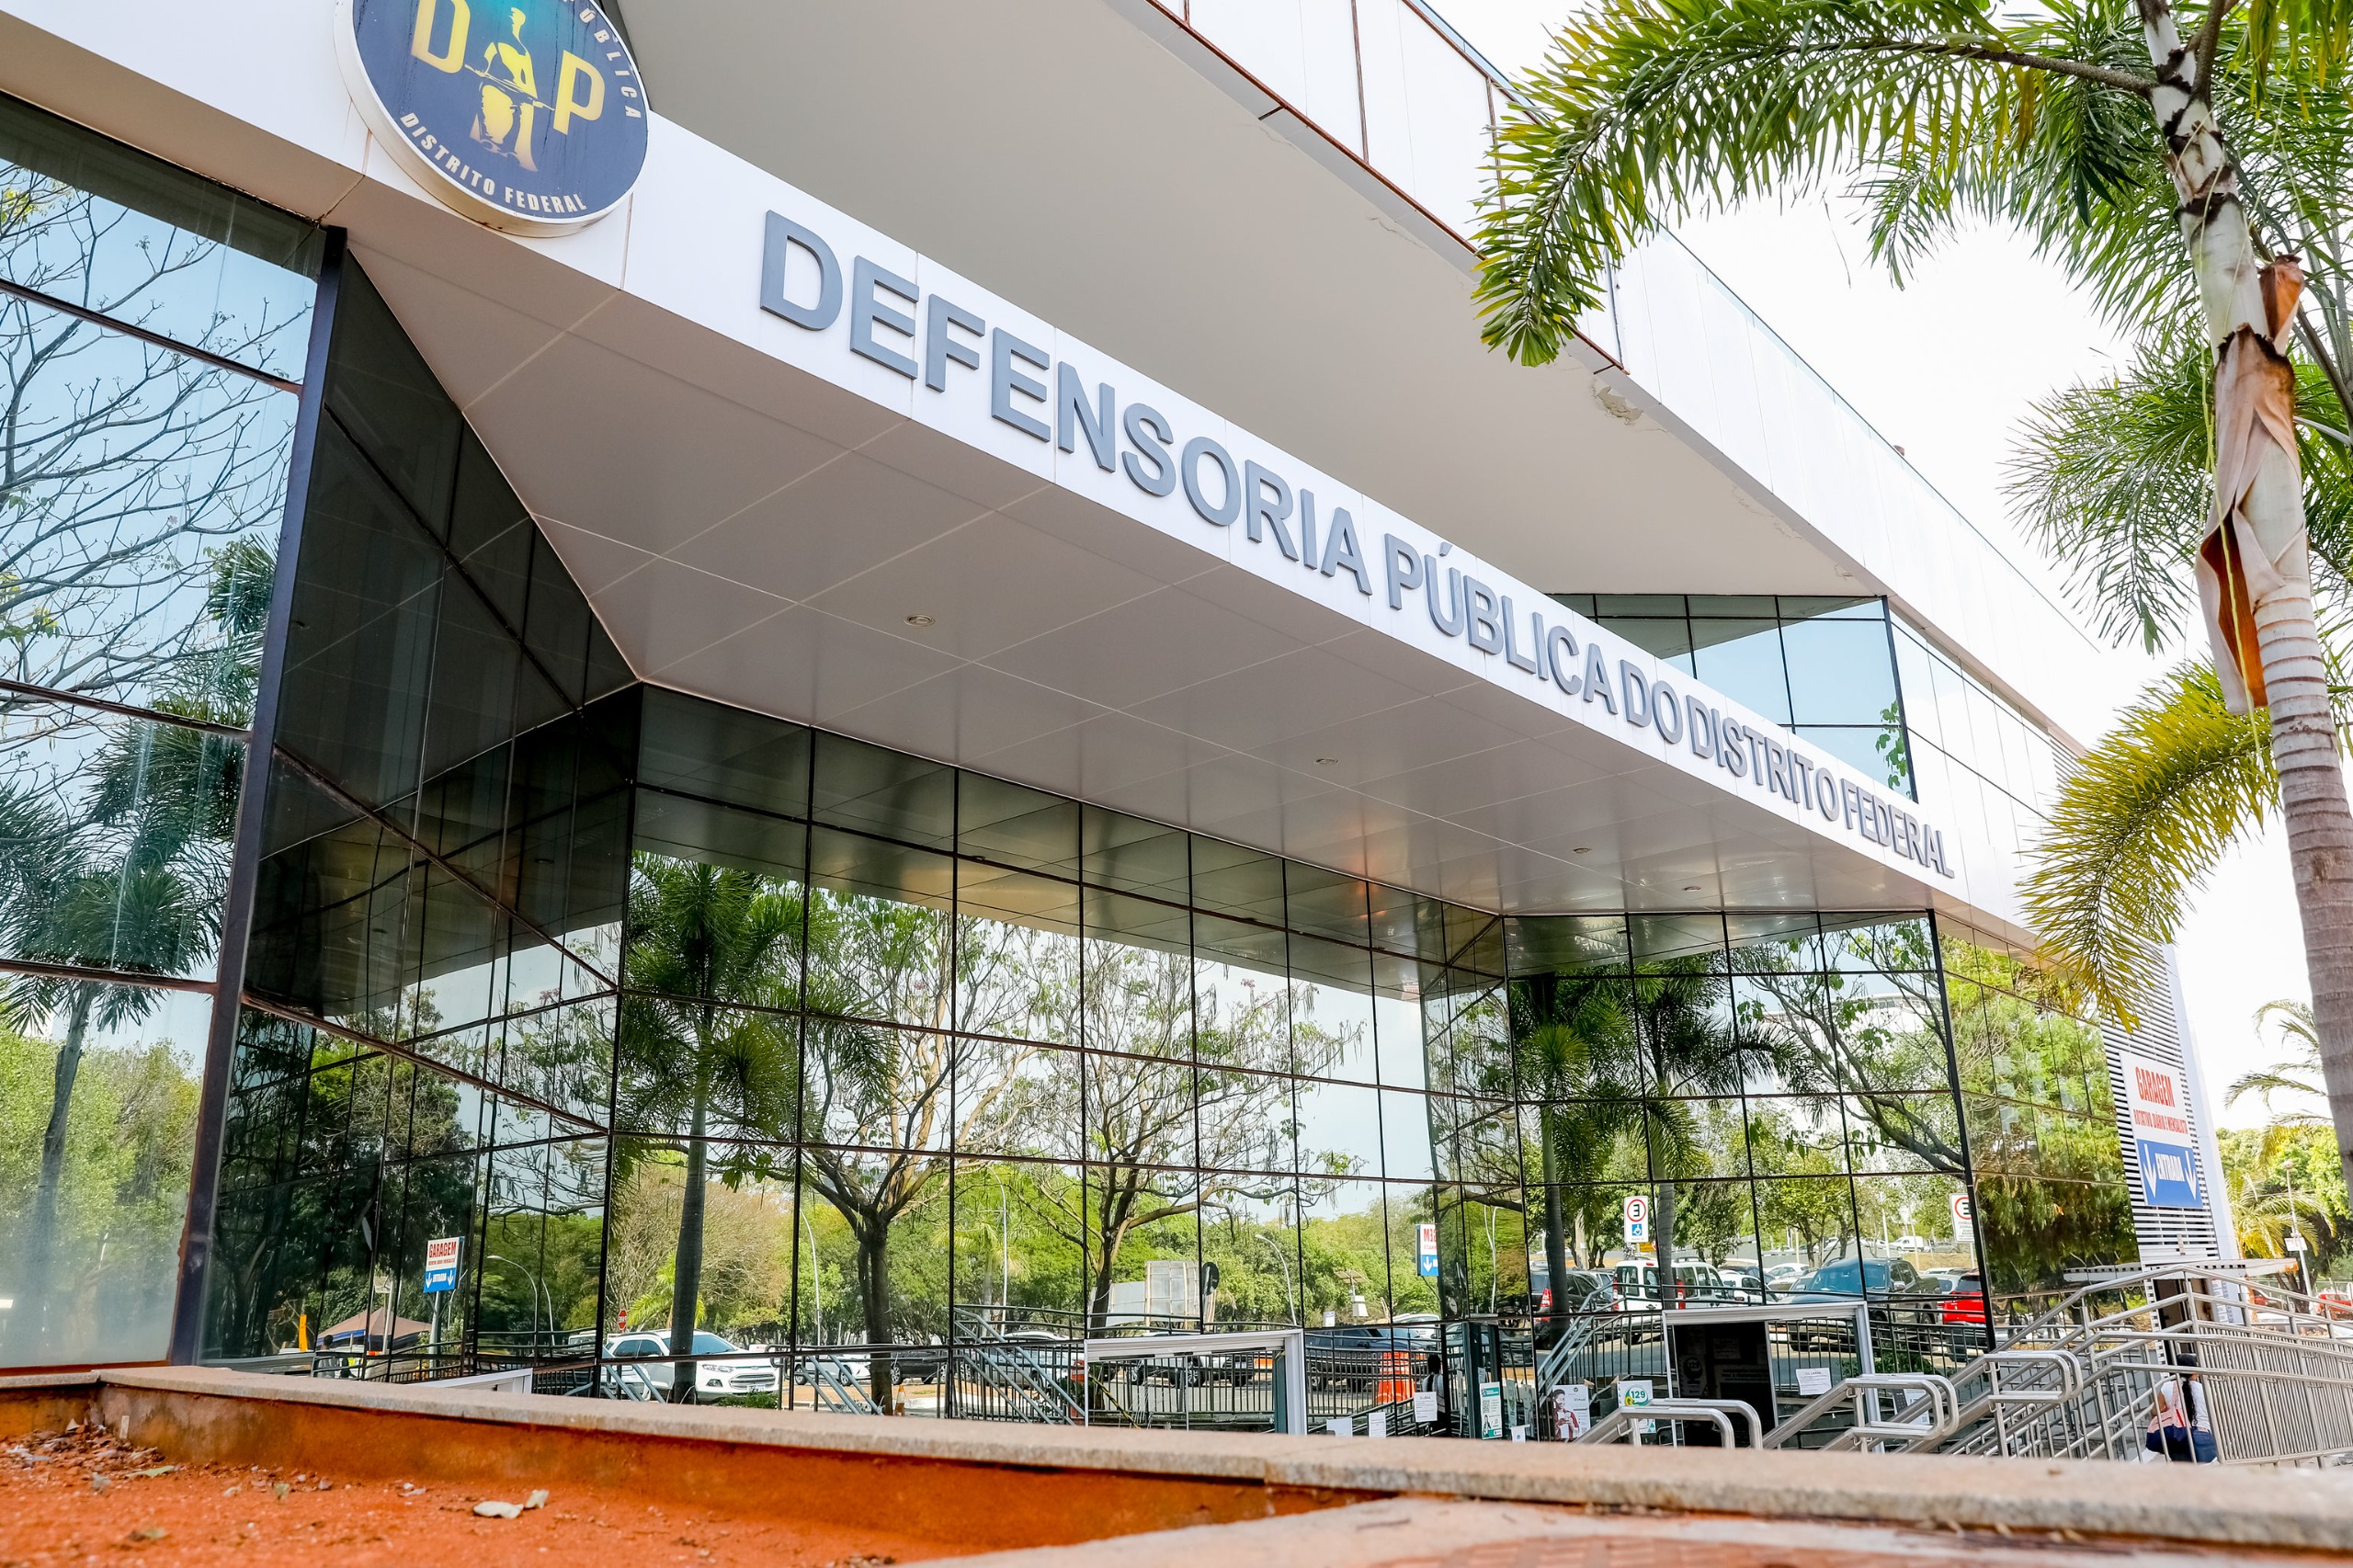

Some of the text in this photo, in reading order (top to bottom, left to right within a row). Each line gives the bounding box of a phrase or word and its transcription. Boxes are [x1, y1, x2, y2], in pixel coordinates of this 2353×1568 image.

[563, 0, 642, 119] ÚBLICA
[400, 112, 587, 213] DISTRITO FEDERAL
[760, 210, 1955, 879] DEFENSORIA PÚBLICA DO DISTRITO FEDERAL
[2135, 1066, 2175, 1108] GARAGEM
[2154, 1153, 2186, 1182] ENTRADA
[429, 1242, 457, 1258] GARAGEM
[1631, 1391, 1646, 1399] 129
